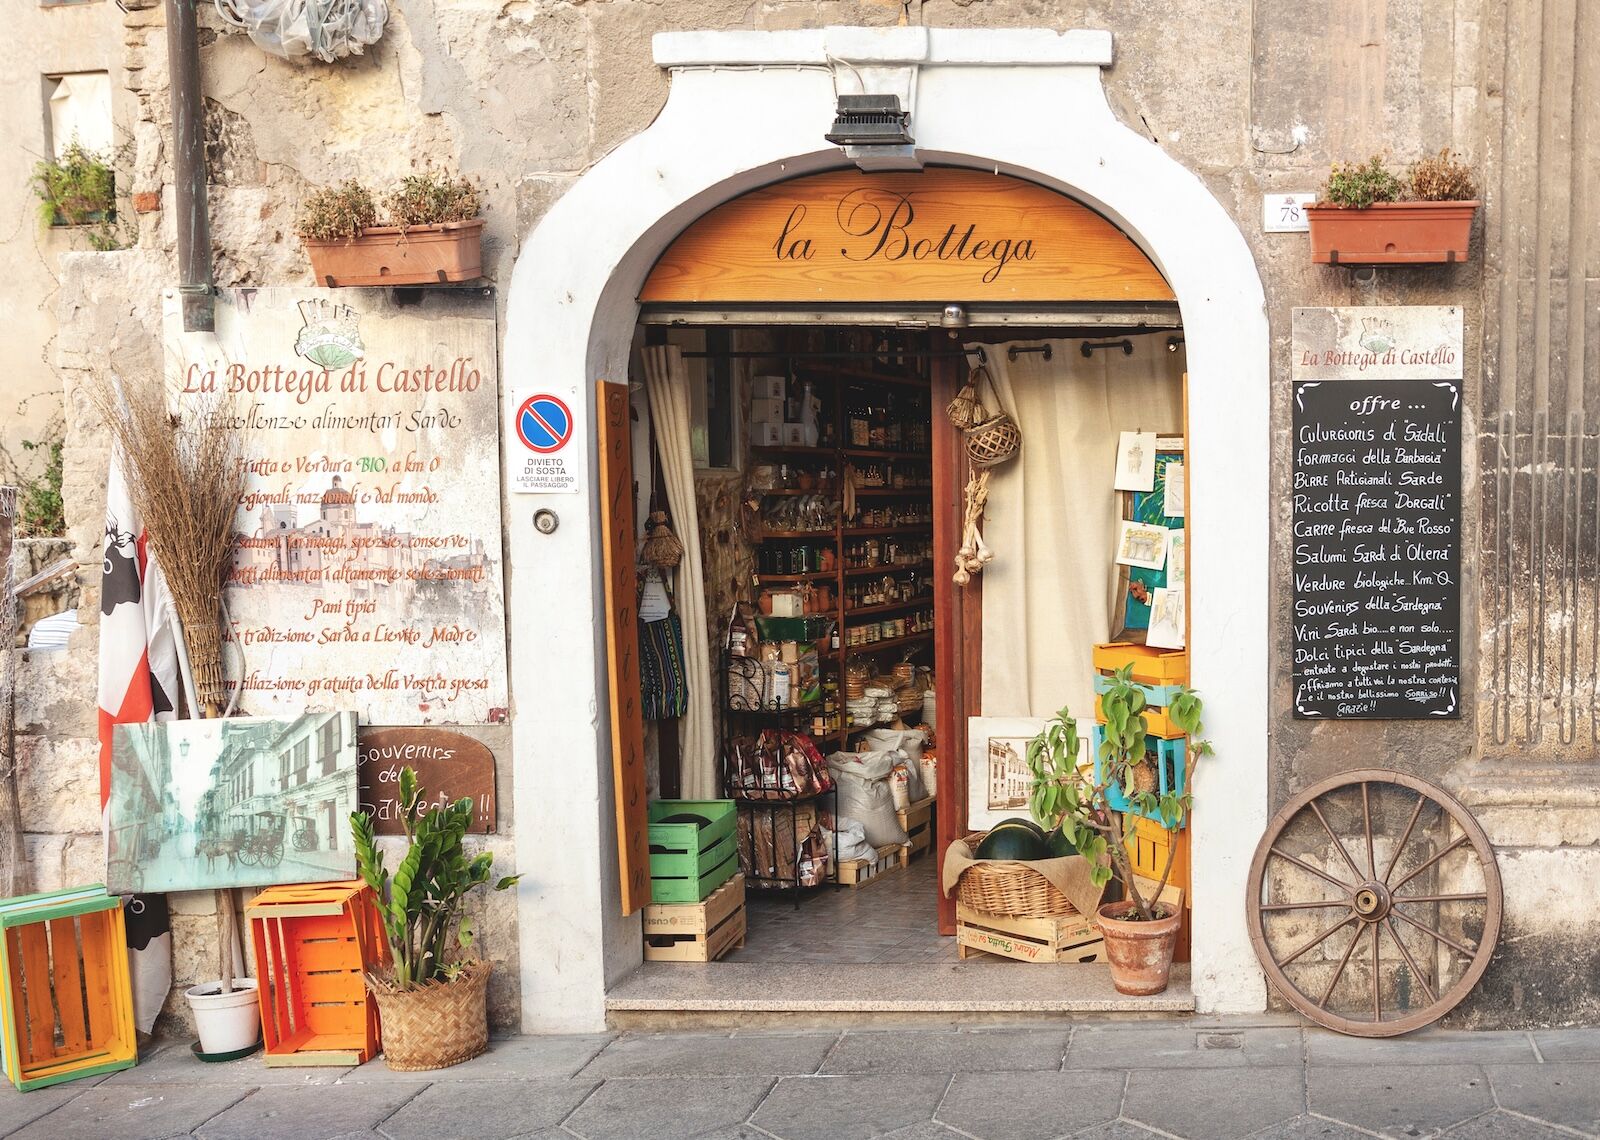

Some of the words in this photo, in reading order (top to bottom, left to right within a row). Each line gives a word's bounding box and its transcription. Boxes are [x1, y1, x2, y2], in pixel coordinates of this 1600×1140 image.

[1281, 207, 1299, 222] 78
[772, 204, 816, 261] la
[836, 187, 1037, 284] Bottega
[1301, 350, 1318, 366] La
[1324, 350, 1377, 371] Bottega
[1382, 346, 1397, 366] di
[1401, 345, 1455, 366] Castello
[182, 362, 218, 393] La
[226, 364, 332, 404] Bottega
[341, 358, 368, 393] di
[376, 358, 481, 393] Castello
[1350, 395, 1400, 415] offre
[312, 403, 402, 432] alimentari
[405, 408, 461, 432] Sarde
[1383, 420, 1397, 442] di
[281, 461, 292, 473] e
[296, 455, 352, 473] Verdura
[393, 461, 401, 473] a
[404, 450, 424, 473] km
[1362, 448, 1391, 464] della
[524, 467, 534, 475] DI
[536, 467, 566, 475] SOSTA
[1398, 471, 1443, 487] Sarde
[239, 482, 292, 511] egionali,
[361, 492, 371, 504] e
[373, 482, 396, 504] dal
[397, 487, 439, 504] mondo.
[1294, 493, 1349, 513] Ricotta
[1294, 520, 1335, 538] Carne
[1378, 518, 1391, 534] del
[408, 534, 469, 549] conserve
[1296, 544, 1347, 565] Salumi
[1353, 543, 1386, 563] Sardi
[1390, 545, 1402, 561] di
[261, 560, 329, 584] alimentari
[332, 558, 402, 584] altamente
[1295, 573, 1345, 592] Verdure
[304, 598, 342, 621] Pani
[346, 598, 376, 624] tipici
[1295, 599, 1359, 617] Souvenirs
[1365, 595, 1390, 610] della
[245, 626, 315, 646] tradizione
[317, 624, 360, 645] Sarda
[362, 632, 371, 643] a
[374, 625, 421, 643] Lievito
[423, 626, 477, 648] Madre
[1294, 623, 1320, 641] Vini
[1324, 622, 1359, 639] Sardi
[1399, 625, 1415, 633] non
[1295, 647, 1329, 664] Dolci
[1334, 644, 1366, 660] tipici
[1371, 641, 1394, 655] della
[1352, 660, 1389, 676] degustare
[307, 674, 363, 696] gratuita
[367, 669, 399, 690] della
[402, 673, 447, 694] Vostra
[450, 678, 489, 701] spesa
[1300, 678, 1343, 692] offriamo
[1354, 675, 1373, 687] tutti
[1387, 675, 1396, 685] la
[1398, 674, 1426, 685] nostra
[1317, 691, 1324, 701] il
[1328, 689, 1354, 700] nostro
[1358, 689, 1399, 699] bellissimo
[988, 936, 1012, 953] Frutta
